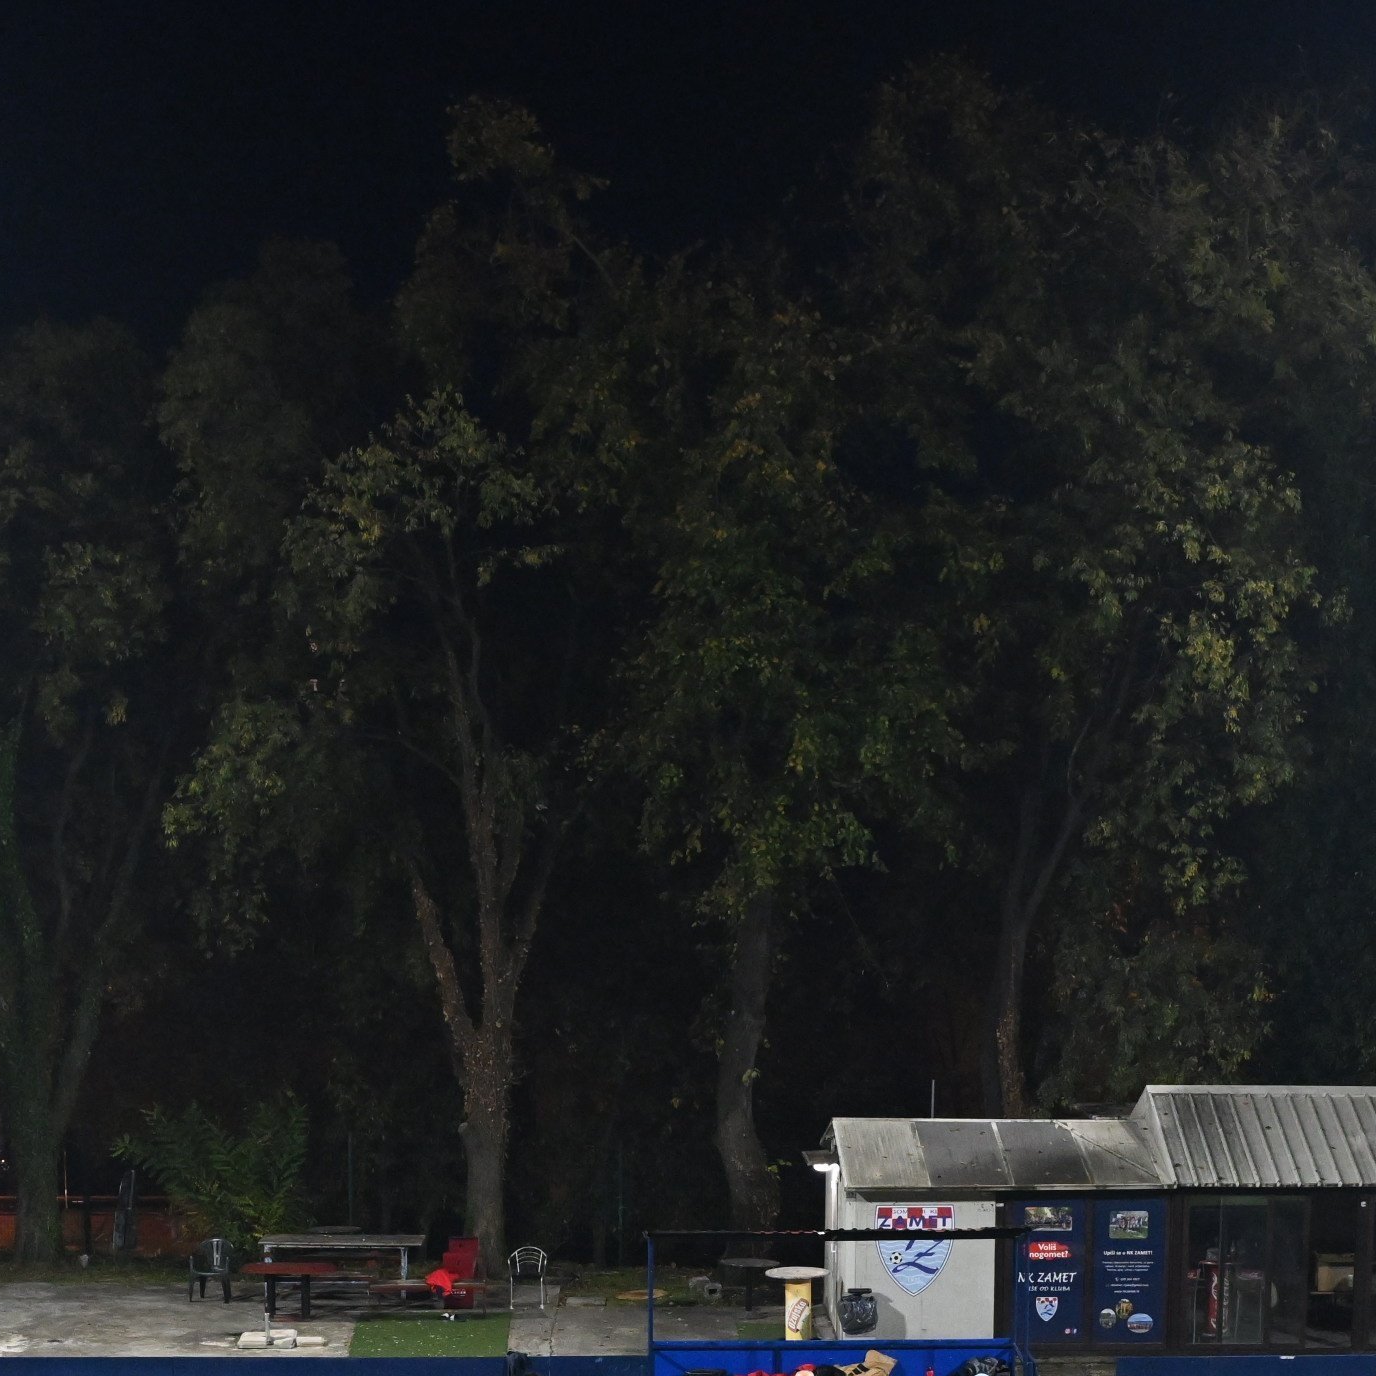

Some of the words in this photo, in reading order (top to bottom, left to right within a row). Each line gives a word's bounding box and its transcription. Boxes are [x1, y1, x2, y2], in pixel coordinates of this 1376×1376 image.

[879, 1216, 949, 1228] ZAMET
[1037, 1243, 1057, 1251] Voliš
[1029, 1250, 1069, 1260] nogomet?
[1037, 1271, 1078, 1283] ZAMET
